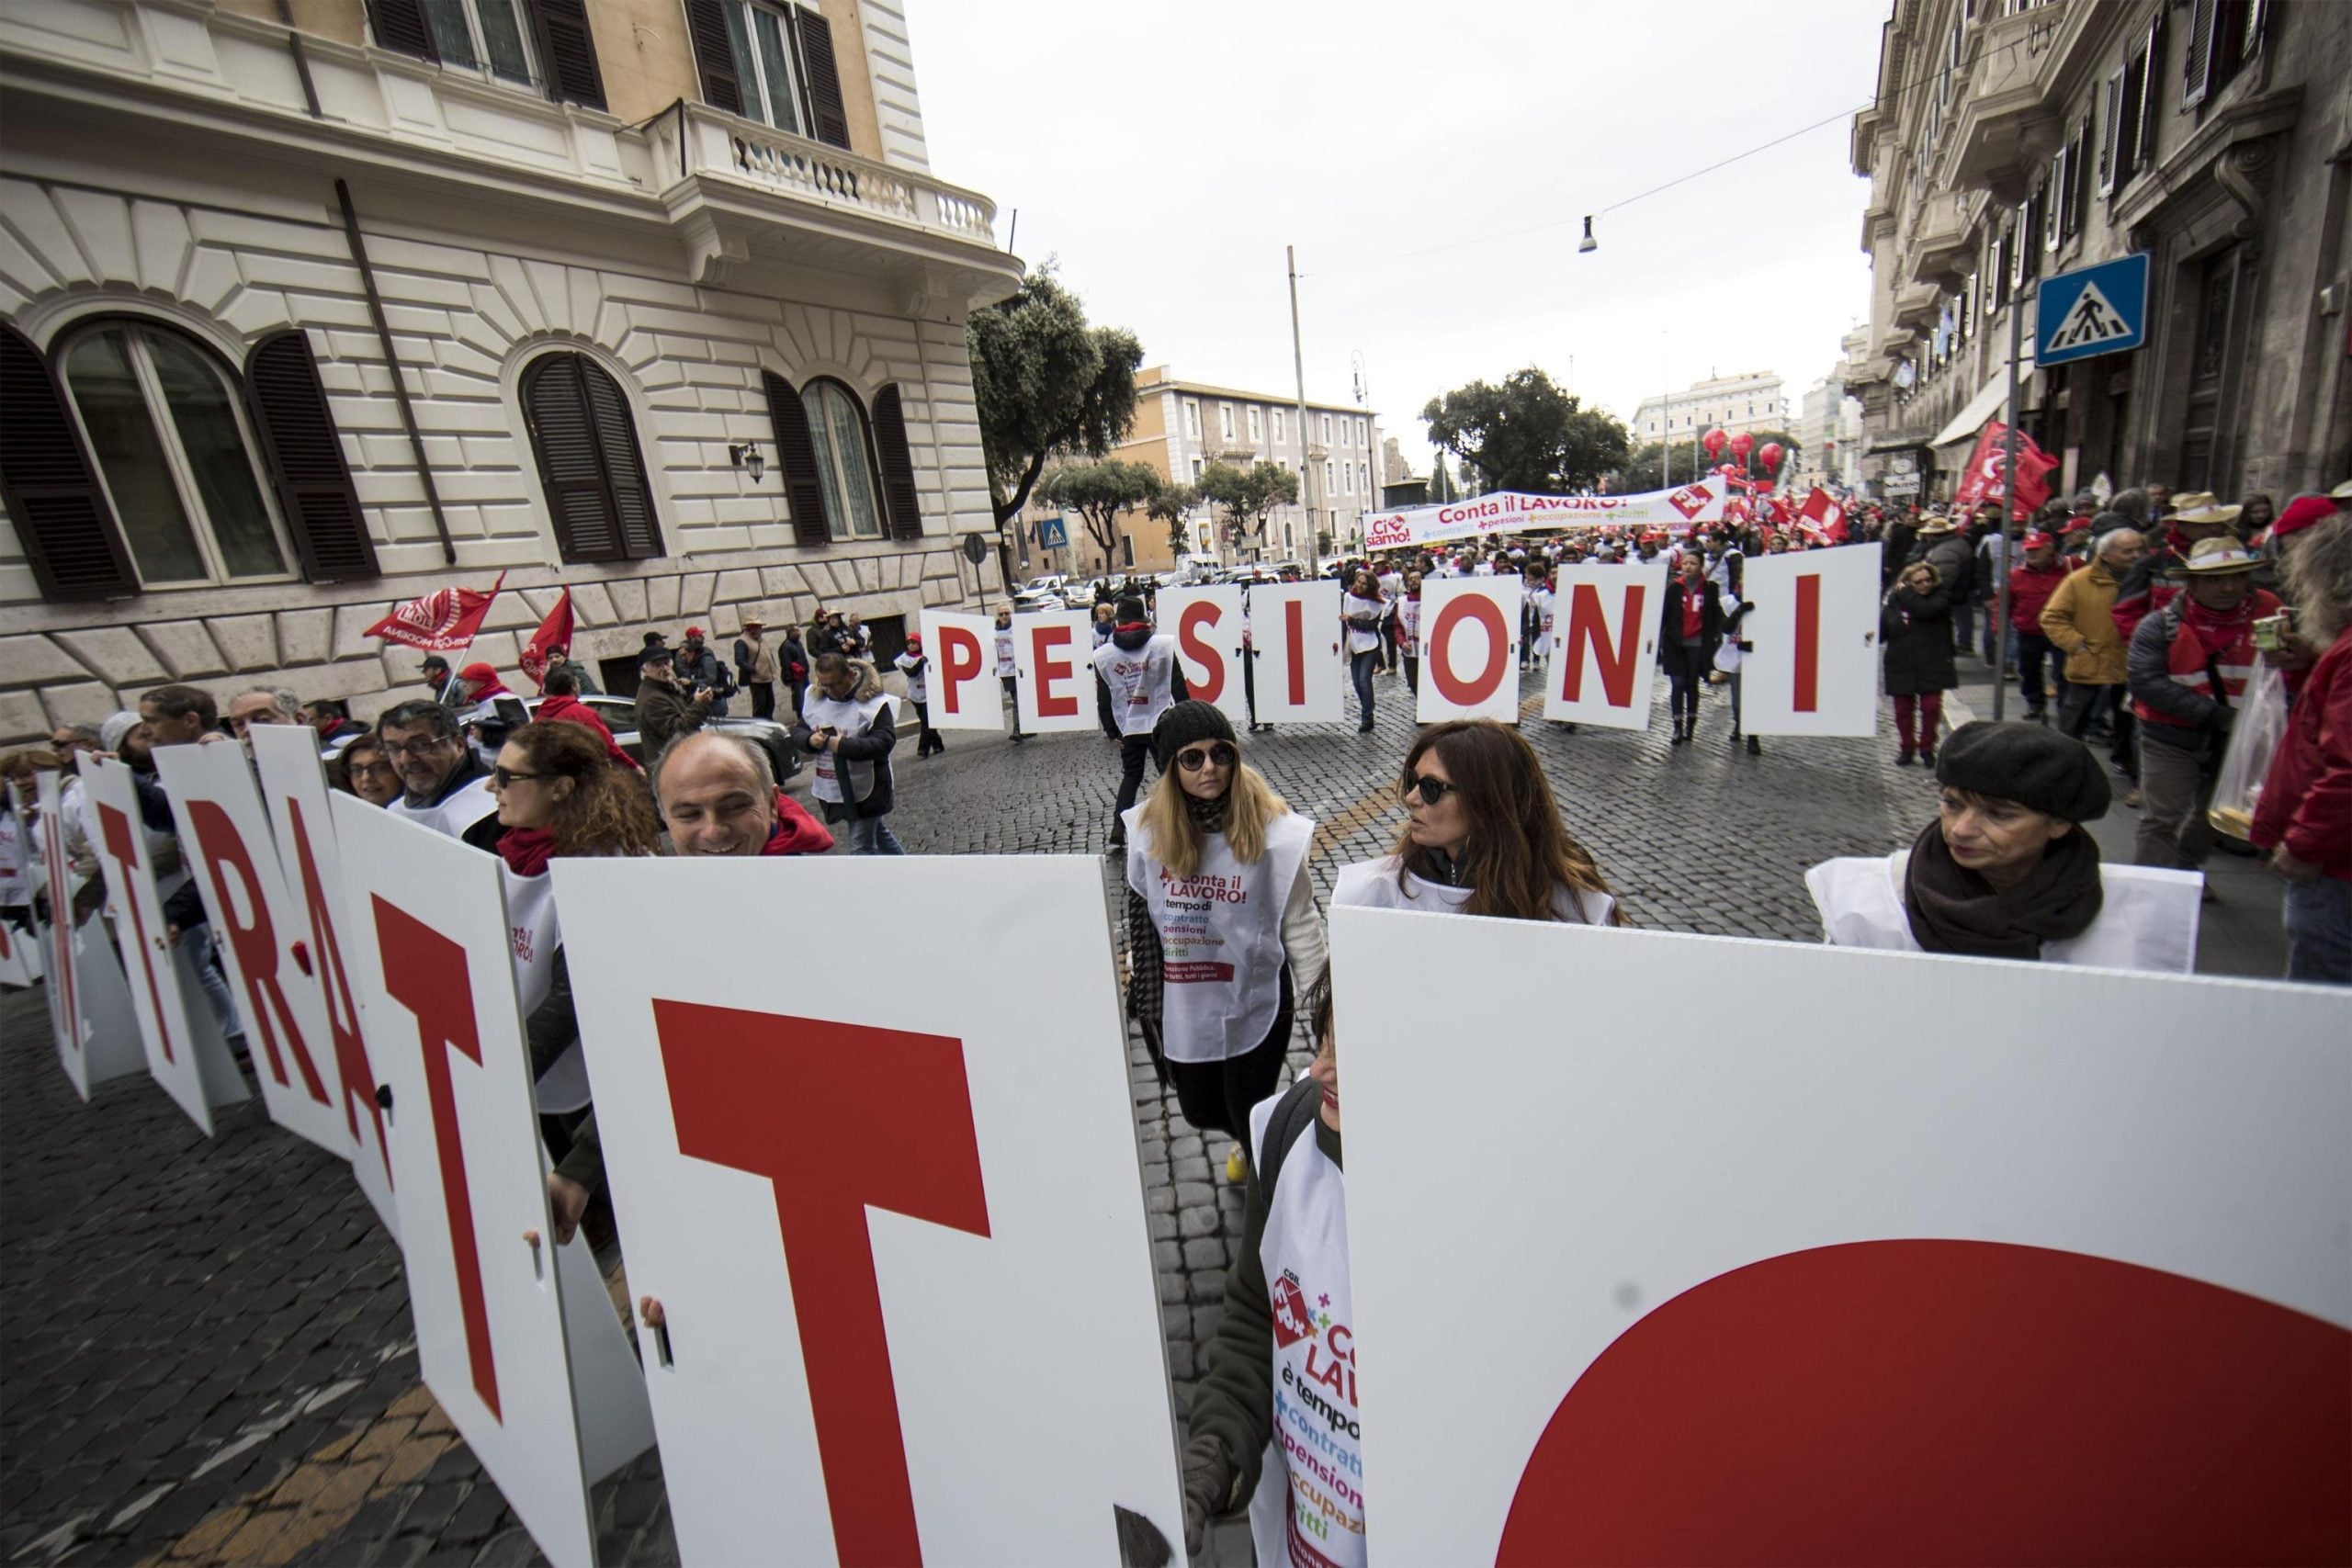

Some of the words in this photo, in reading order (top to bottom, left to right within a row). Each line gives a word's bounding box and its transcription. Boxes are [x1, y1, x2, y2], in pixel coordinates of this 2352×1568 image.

[1439, 500, 1499, 525] Conta
[1504, 494, 1515, 513] il
[1366, 528, 1410, 547] siamo!
[938, 626, 983, 714] P
[1032, 626, 1079, 717] E
[1179, 600, 1225, 705] S
[1429, 592, 1509, 706] O
[1563, 583, 1645, 707] N
[1232, 875, 1241, 889] il
[1170, 884, 1247, 905] LAVORO!
[1166, 899, 1201, 912] tempo
[1202, 901, 1213, 911] di
[1163, 914, 1209, 923] contratto
[1163, 925, 1206, 934] pensioni
[186, 800, 333, 1108] R
[653, 999, 991, 1568] T
[1283, 1269, 1301, 1287] CGIL
[1296, 1376, 1361, 1440] tempo
